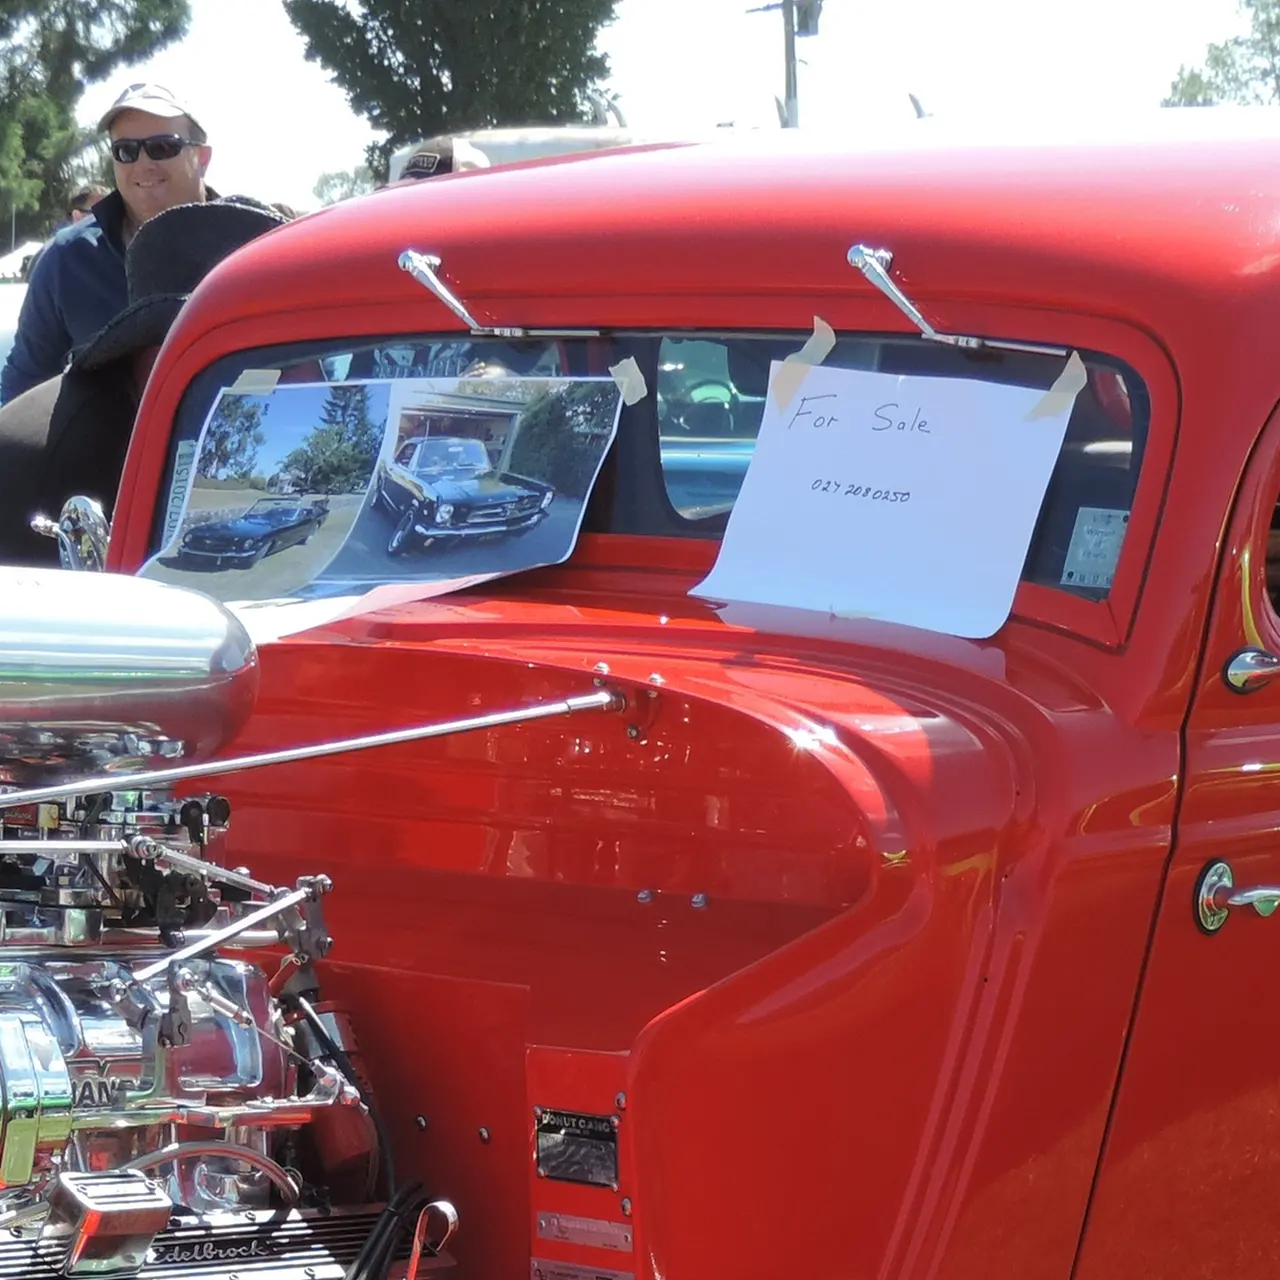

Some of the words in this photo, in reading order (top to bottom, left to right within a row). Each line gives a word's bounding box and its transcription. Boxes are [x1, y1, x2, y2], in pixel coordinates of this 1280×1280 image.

[788, 394, 839, 429] For
[872, 403, 931, 434] Sale
[148, 1240, 269, 1263] Edelbrock
